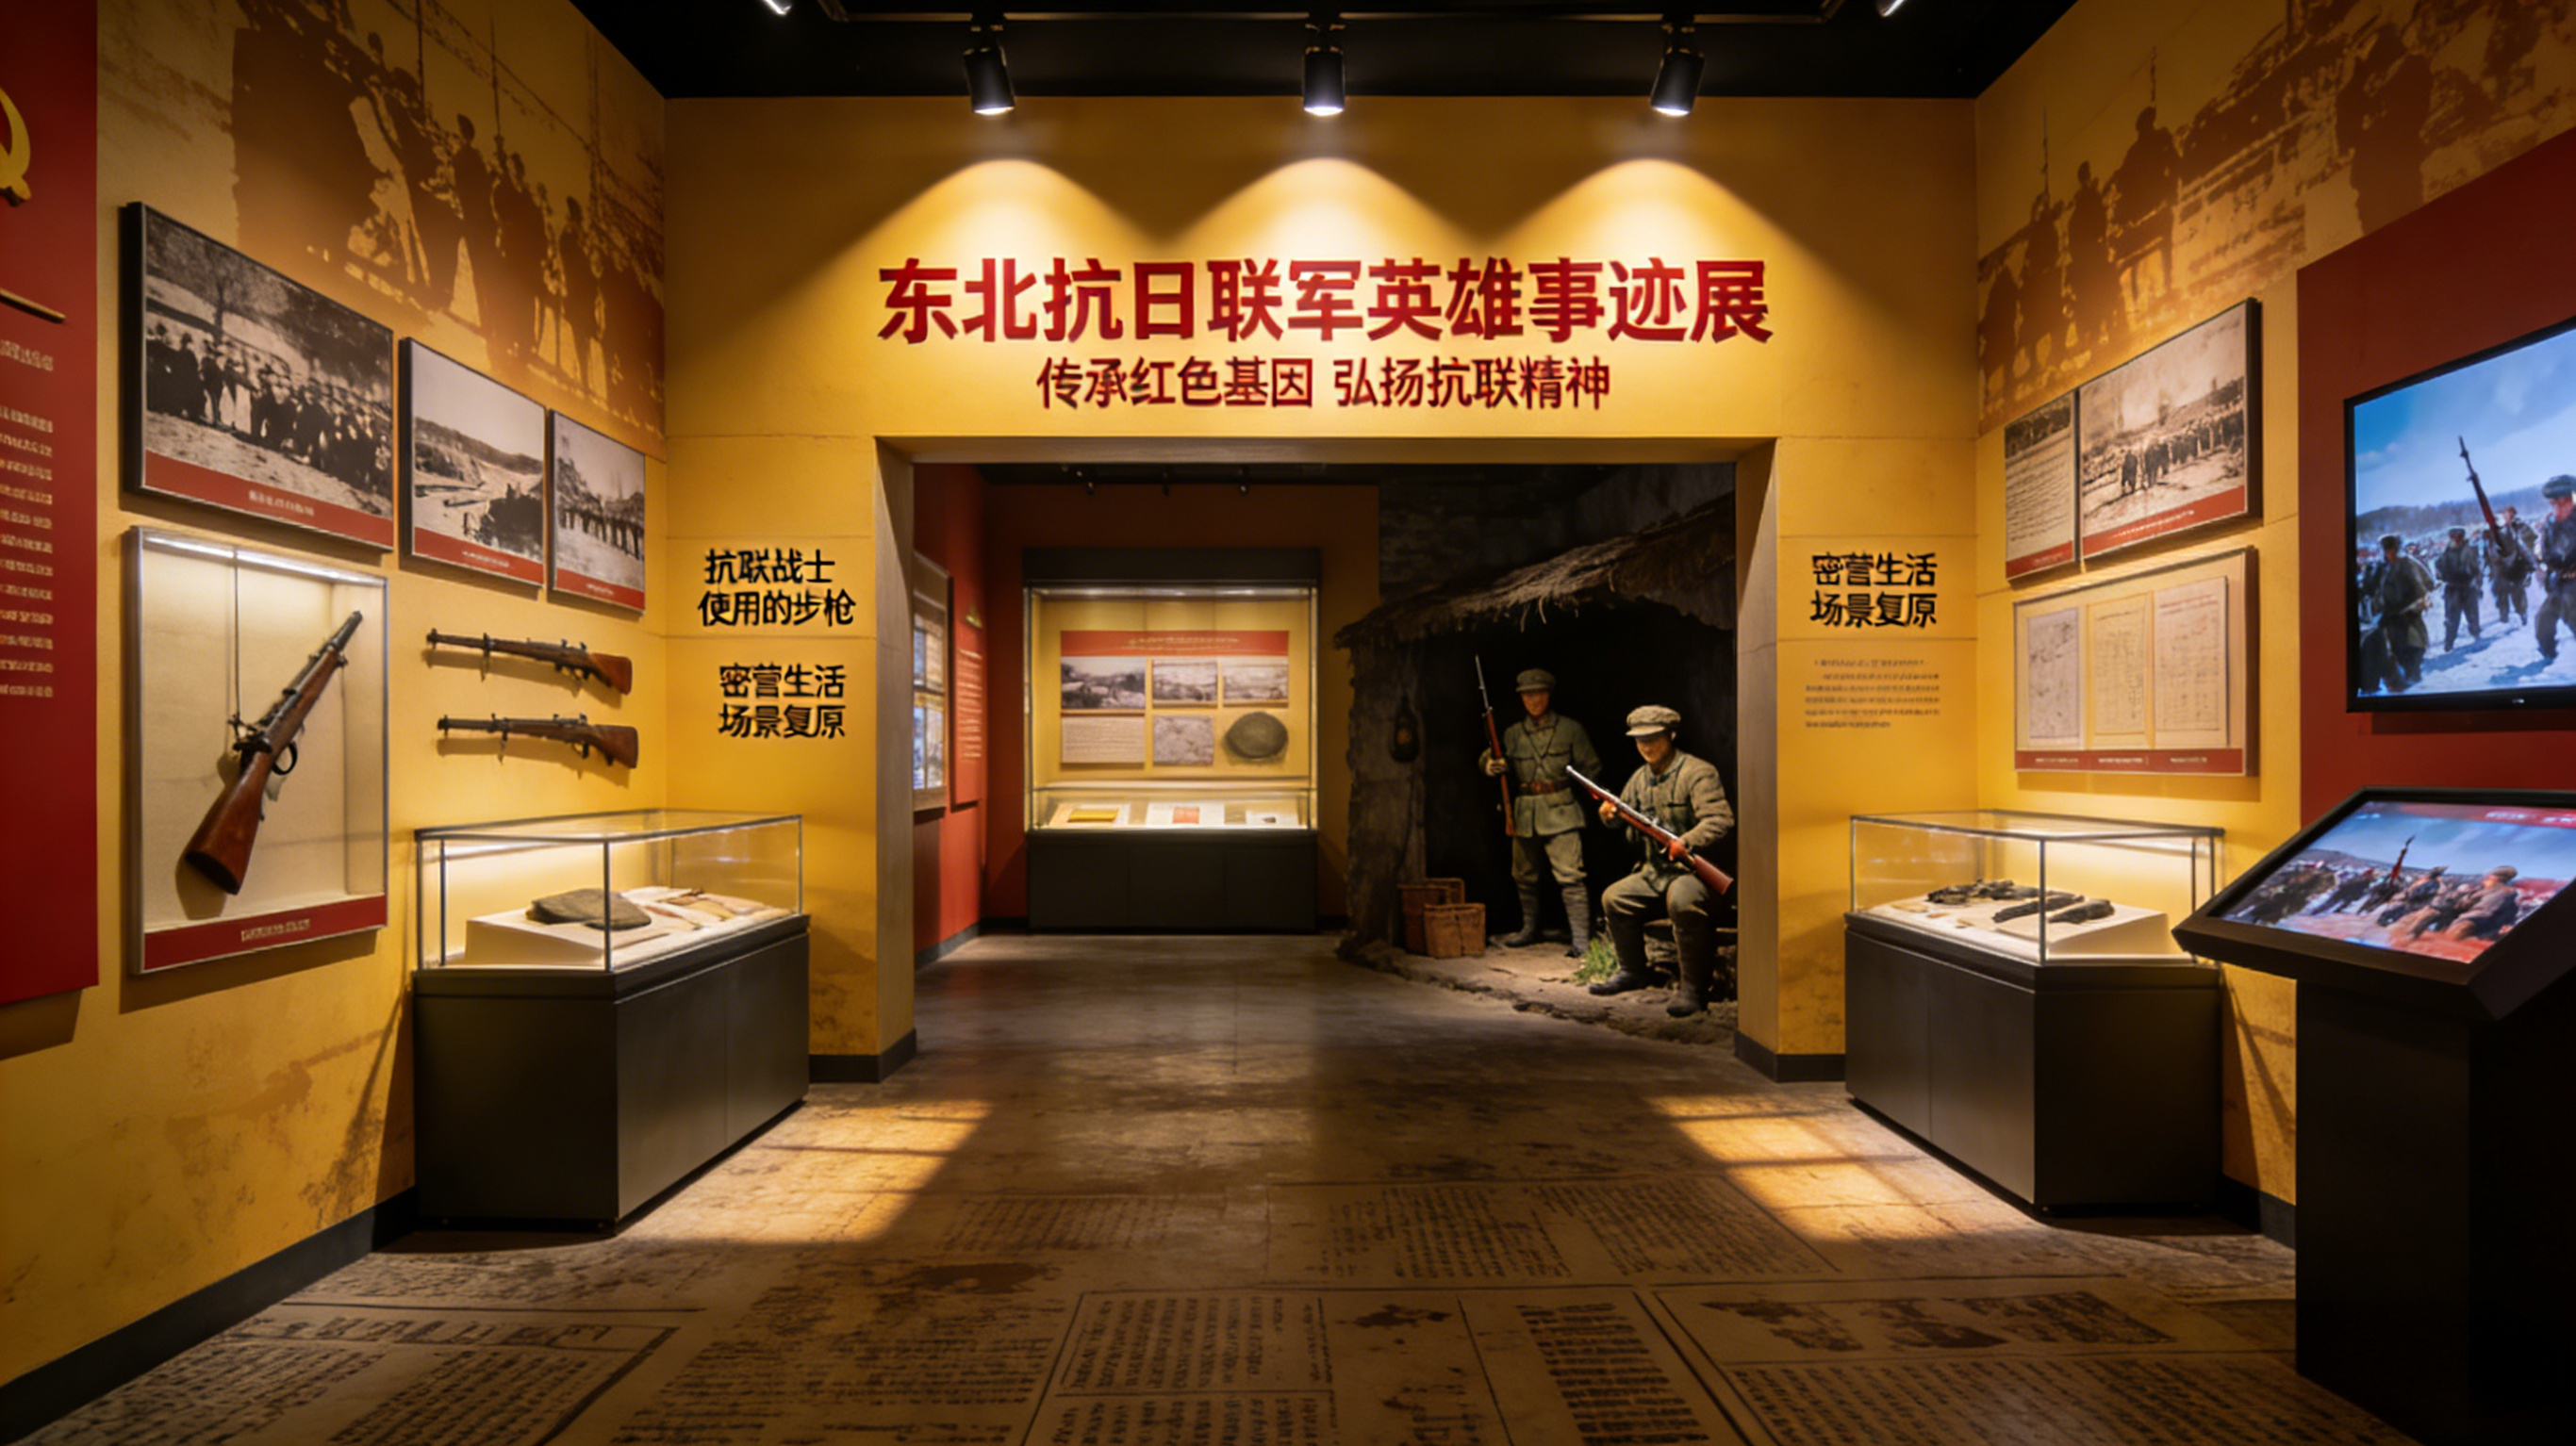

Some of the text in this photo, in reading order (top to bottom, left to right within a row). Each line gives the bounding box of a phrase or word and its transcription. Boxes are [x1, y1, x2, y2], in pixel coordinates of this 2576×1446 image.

[878, 256, 1775, 345] 东北抗日联军英雄事迹展
[1036, 355, 1611, 411] 传承红色基因 弘扬抗联精神
[704, 548, 836, 584] 抗联战士
[698, 588, 857, 628] 使用的步枪
